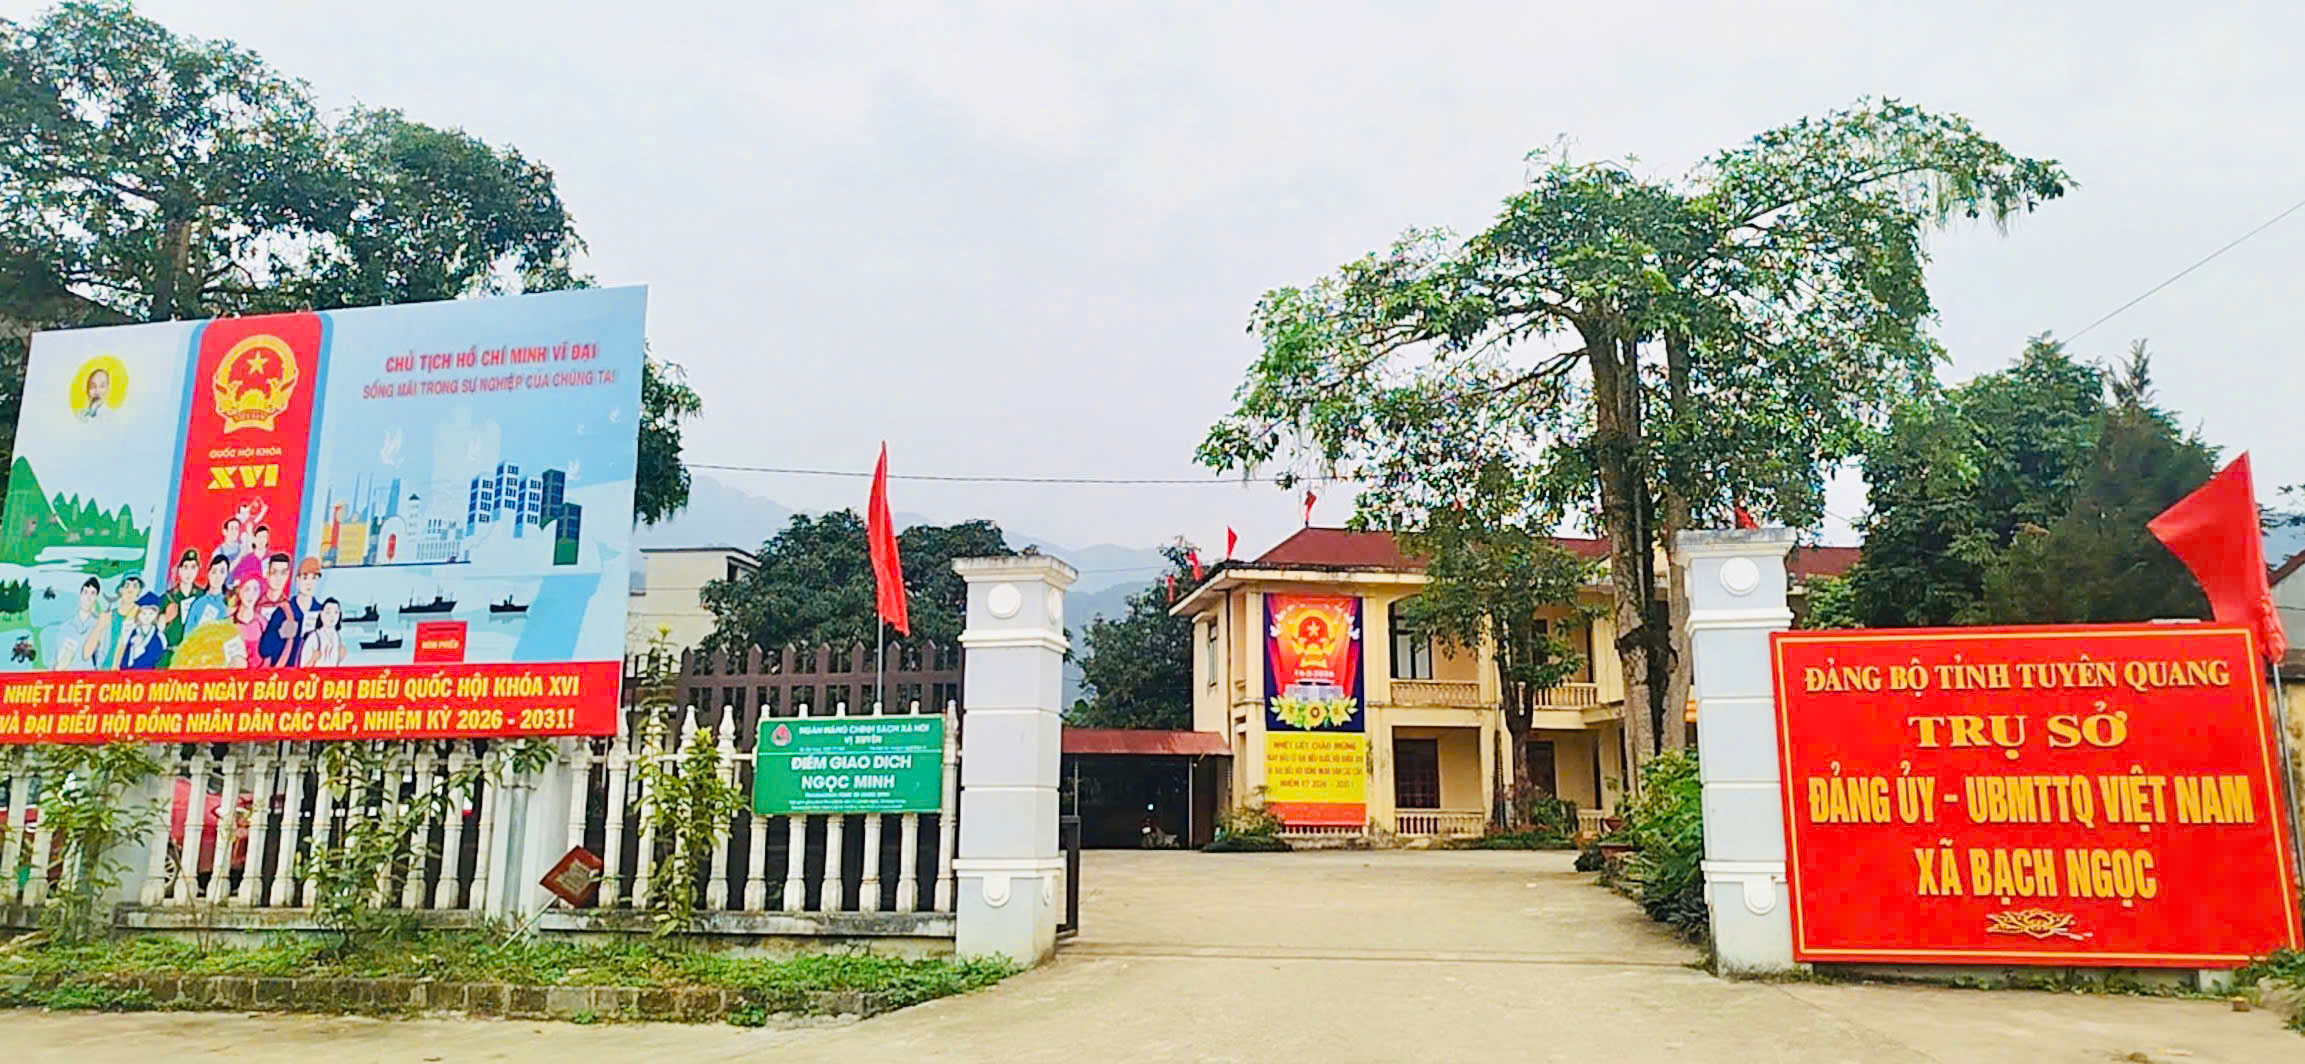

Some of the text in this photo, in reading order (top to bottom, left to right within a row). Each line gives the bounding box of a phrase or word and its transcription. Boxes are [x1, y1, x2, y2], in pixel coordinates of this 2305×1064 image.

[385, 341, 598, 373] CHỦ TỊCH HỒ CHÍ MINH VĨ ĐẠI
[362, 378, 394, 400] SỐNG
[421, 379, 458, 395] TRONG
[479, 374, 522, 393] NGHIỆP
[552, 368, 594, 387] CHÚNG
[208, 464, 279, 489] XVI
[4, 680, 52, 707] NHIỆT
[57, 679, 95, 707] LIỆT
[99, 678, 144, 702] CHÀO
[148, 677, 199, 702] MỪNG
[203, 676, 249, 702] NGÀY
[293, 673, 319, 700] CỬ
[322, 679, 352, 704] ĐẠI
[357, 669, 400, 699] BIỂU
[404, 670, 453, 702] QUỐC
[457, 672, 489, 702] HỘI
[493, 672, 543, 697] KHÓA
[548, 675, 580, 697] XVI
[1804, 654, 2230, 697] ĐẢNG BỘ TỈNH TUYÊN QUANG
[0, 700, 575, 738] VÀ ĐẠI BIỂU HỘI ĐỒNG NHÂN DÂN CÁC CẤP, NHIỆM KỲ 2026 - 2031!
[1908, 700, 2128, 760] TRỤ SỞ
[791, 751, 912, 770] ĐIỂM GIAO DỊCH
[801, 775, 895, 793] NGỌC MINH
[1808, 760, 2255, 833] ĐẢNG ỦY - UBMTTQ VIỆT NAM
[1914, 837, 2157, 908] XÃ BẠCH NGỌC
